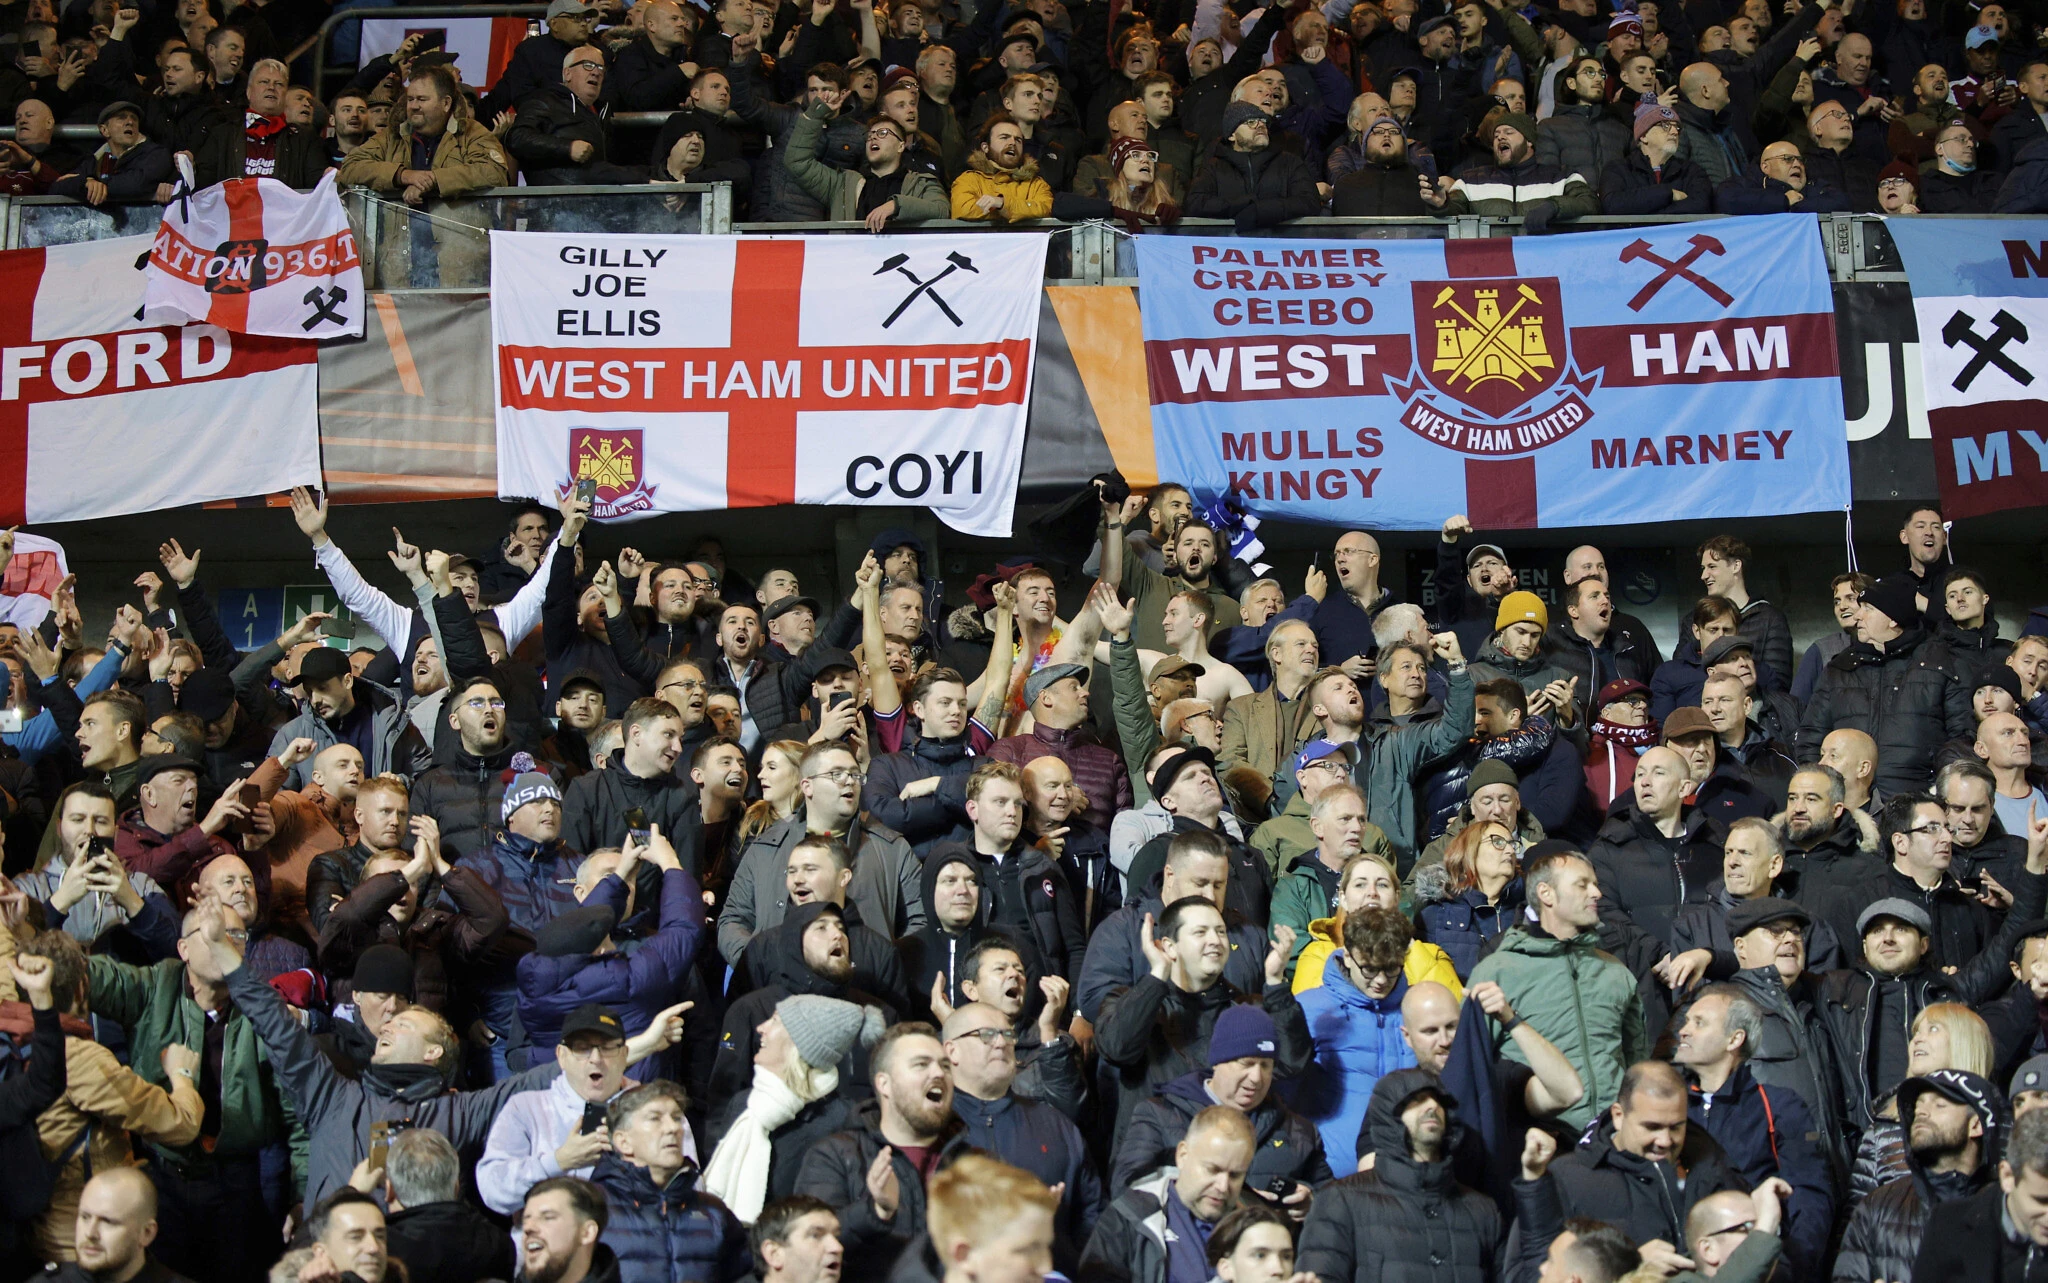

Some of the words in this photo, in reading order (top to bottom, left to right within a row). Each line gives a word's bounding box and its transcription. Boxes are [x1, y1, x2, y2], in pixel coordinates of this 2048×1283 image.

[151, 231, 256, 281] ATION
[559, 246, 668, 268] GILLY
[1192, 245, 1384, 268] PALMER
[572, 273, 647, 298] JOE
[1193, 268, 1388, 291] CRABBY
[557, 309, 661, 337] ELLIS
[1213, 296, 1374, 326] CEEBO
[1, 325, 232, 401] FORD
[513, 357, 666, 400] WEST
[683, 359, 802, 399] HAM
[822, 352, 1013, 399] UNITED
[1170, 344, 1377, 395] WEST
[1629, 325, 1790, 378] HAM
[1410, 405, 1464, 446] WEST
[1466, 428, 1514, 451] HAM
[1517, 402, 1584, 447] UNITED
[1221, 427, 1384, 462] MULLS
[1591, 429, 1794, 470] MARNEY
[846, 450, 984, 499] COYI
[1228, 467, 1383, 501] KINGY
[593, 504, 618, 517] HAM
[242, 593, 259, 618] A
[244, 622, 253, 648] 1
